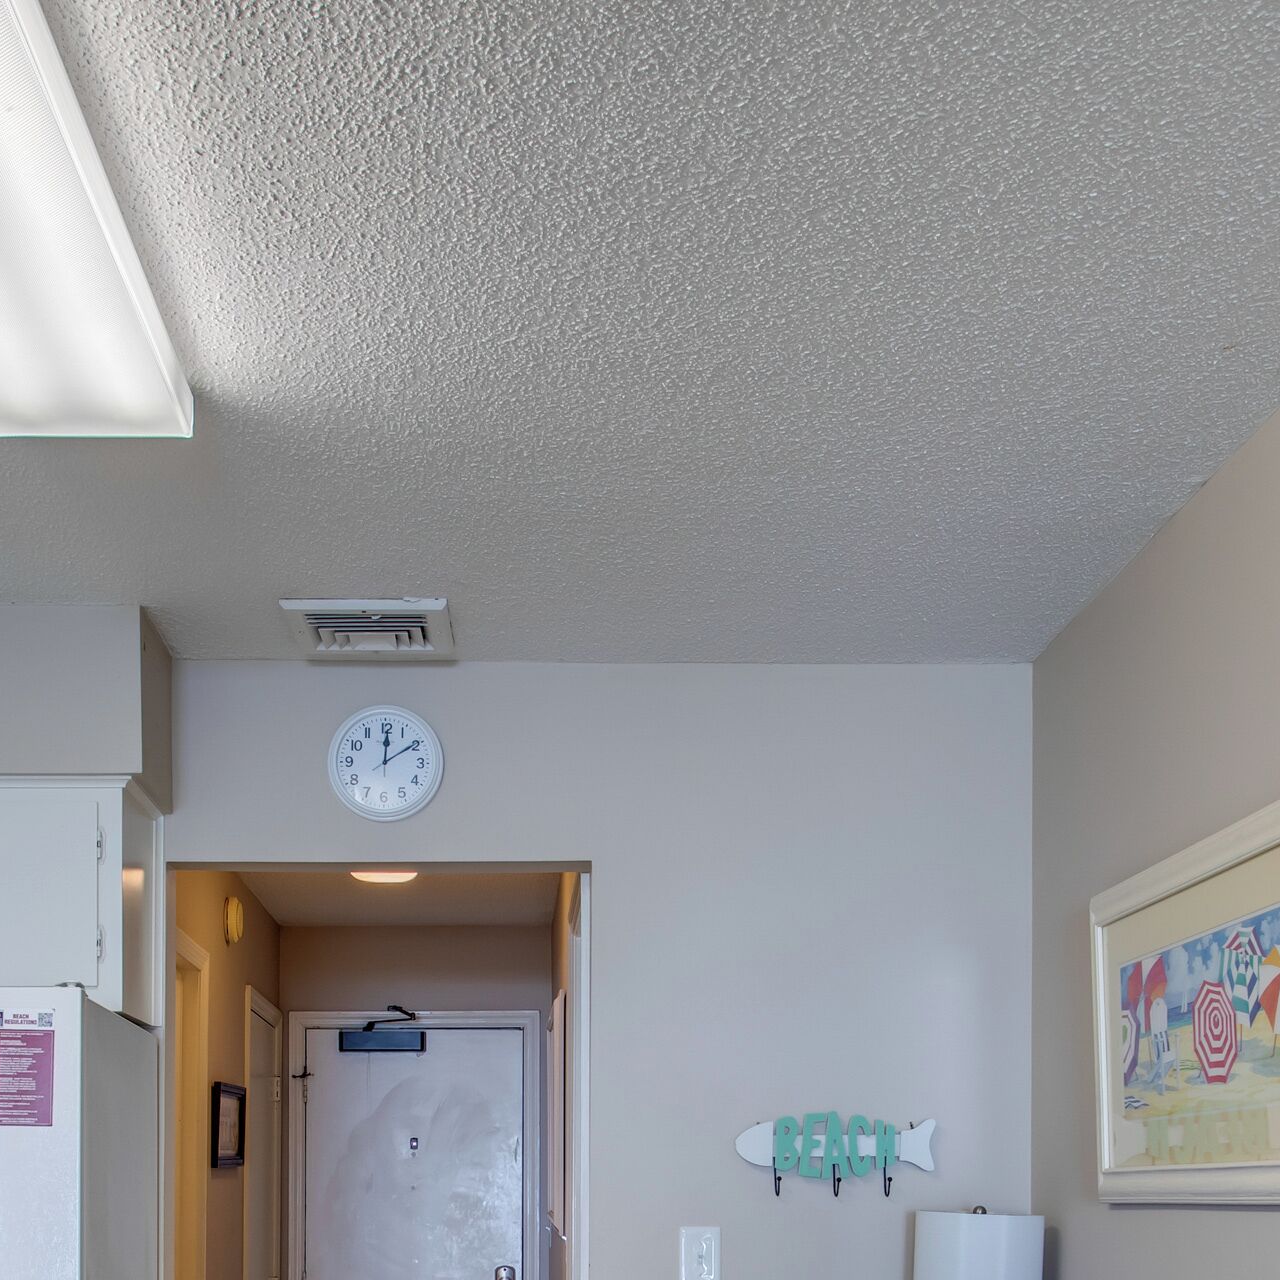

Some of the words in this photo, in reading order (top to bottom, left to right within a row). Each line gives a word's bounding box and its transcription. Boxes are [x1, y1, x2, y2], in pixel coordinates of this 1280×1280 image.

[364, 727, 371, 739] 11
[381, 723, 393, 734] 12
[350, 740, 363, 751] 10
[411, 740, 420, 751] 2
[345, 756, 354, 768] 9
[416, 757, 425, 769] 3
[350, 774, 359, 786] 8
[410, 775, 420, 786] 4
[363, 787, 371, 798] 7
[380, 791, 388, 803] 6
[397, 787, 406, 799] 5
[774, 1110, 896, 1180] BEACH
